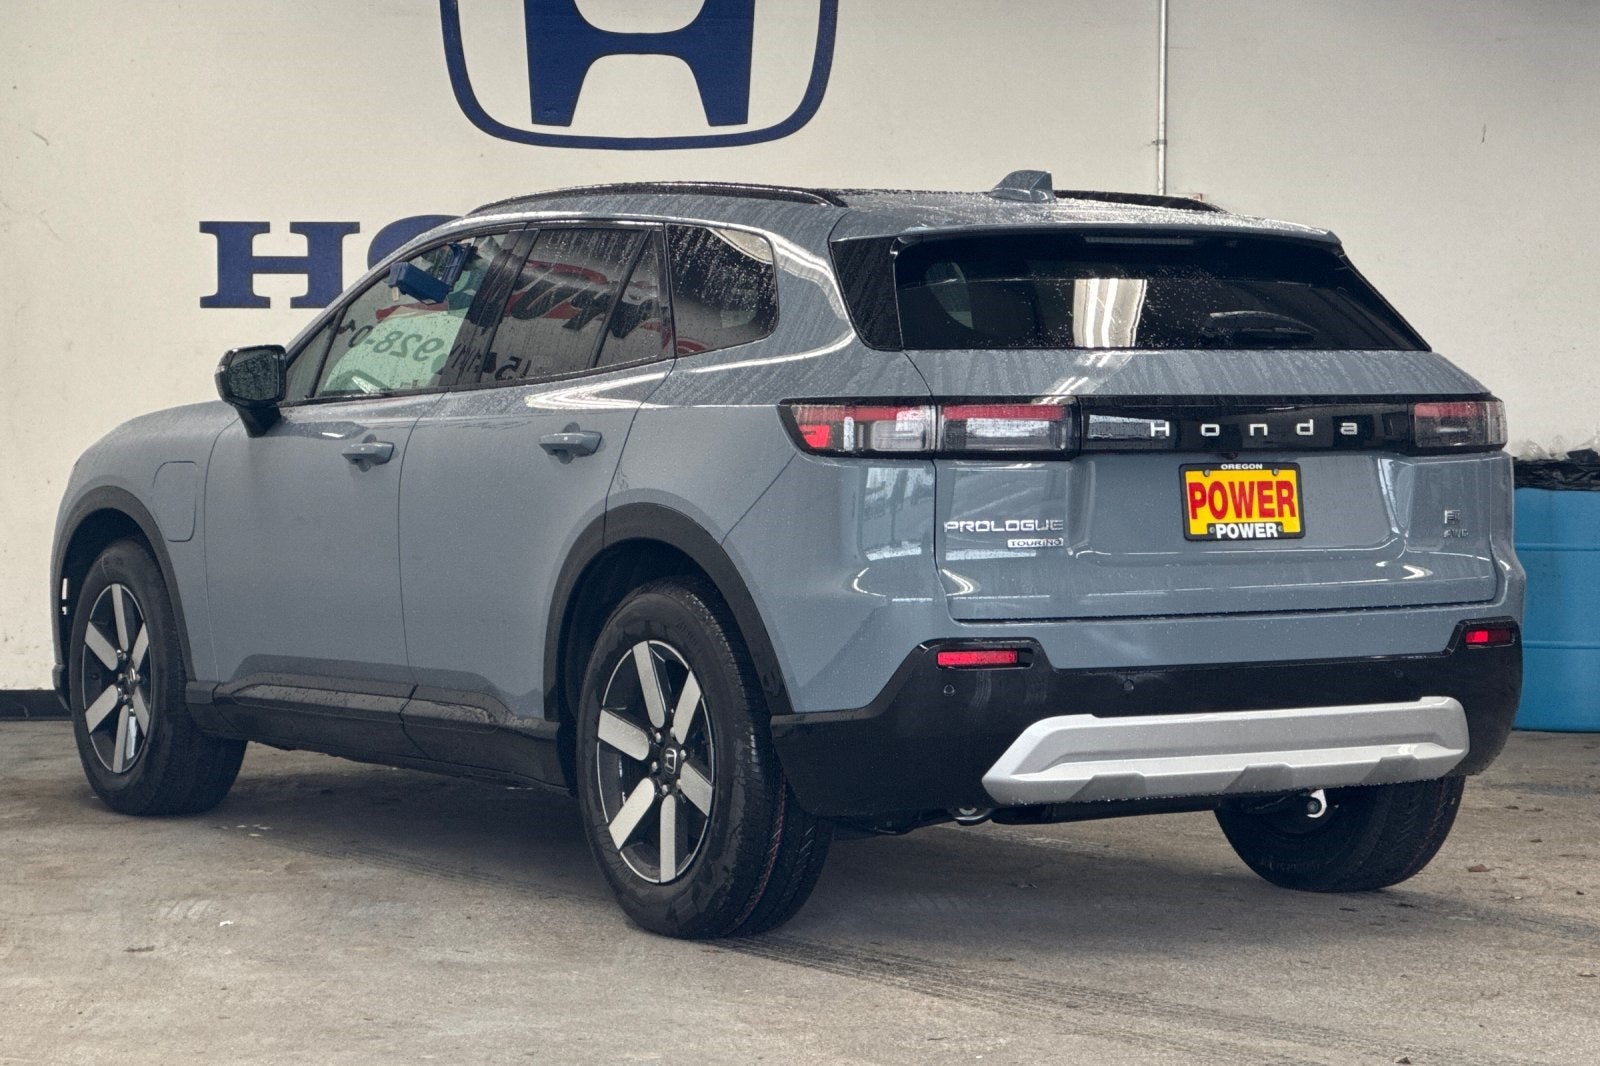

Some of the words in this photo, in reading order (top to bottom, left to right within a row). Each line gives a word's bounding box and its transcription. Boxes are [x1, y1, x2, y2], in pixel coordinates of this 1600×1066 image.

[1150, 418, 1358, 437] Honda
[1188, 480, 1297, 520] POWER
[943, 519, 1064, 533] PROLOGUE
[1215, 522, 1278, 539] POWER
[1007, 538, 1064, 548] TOURING
